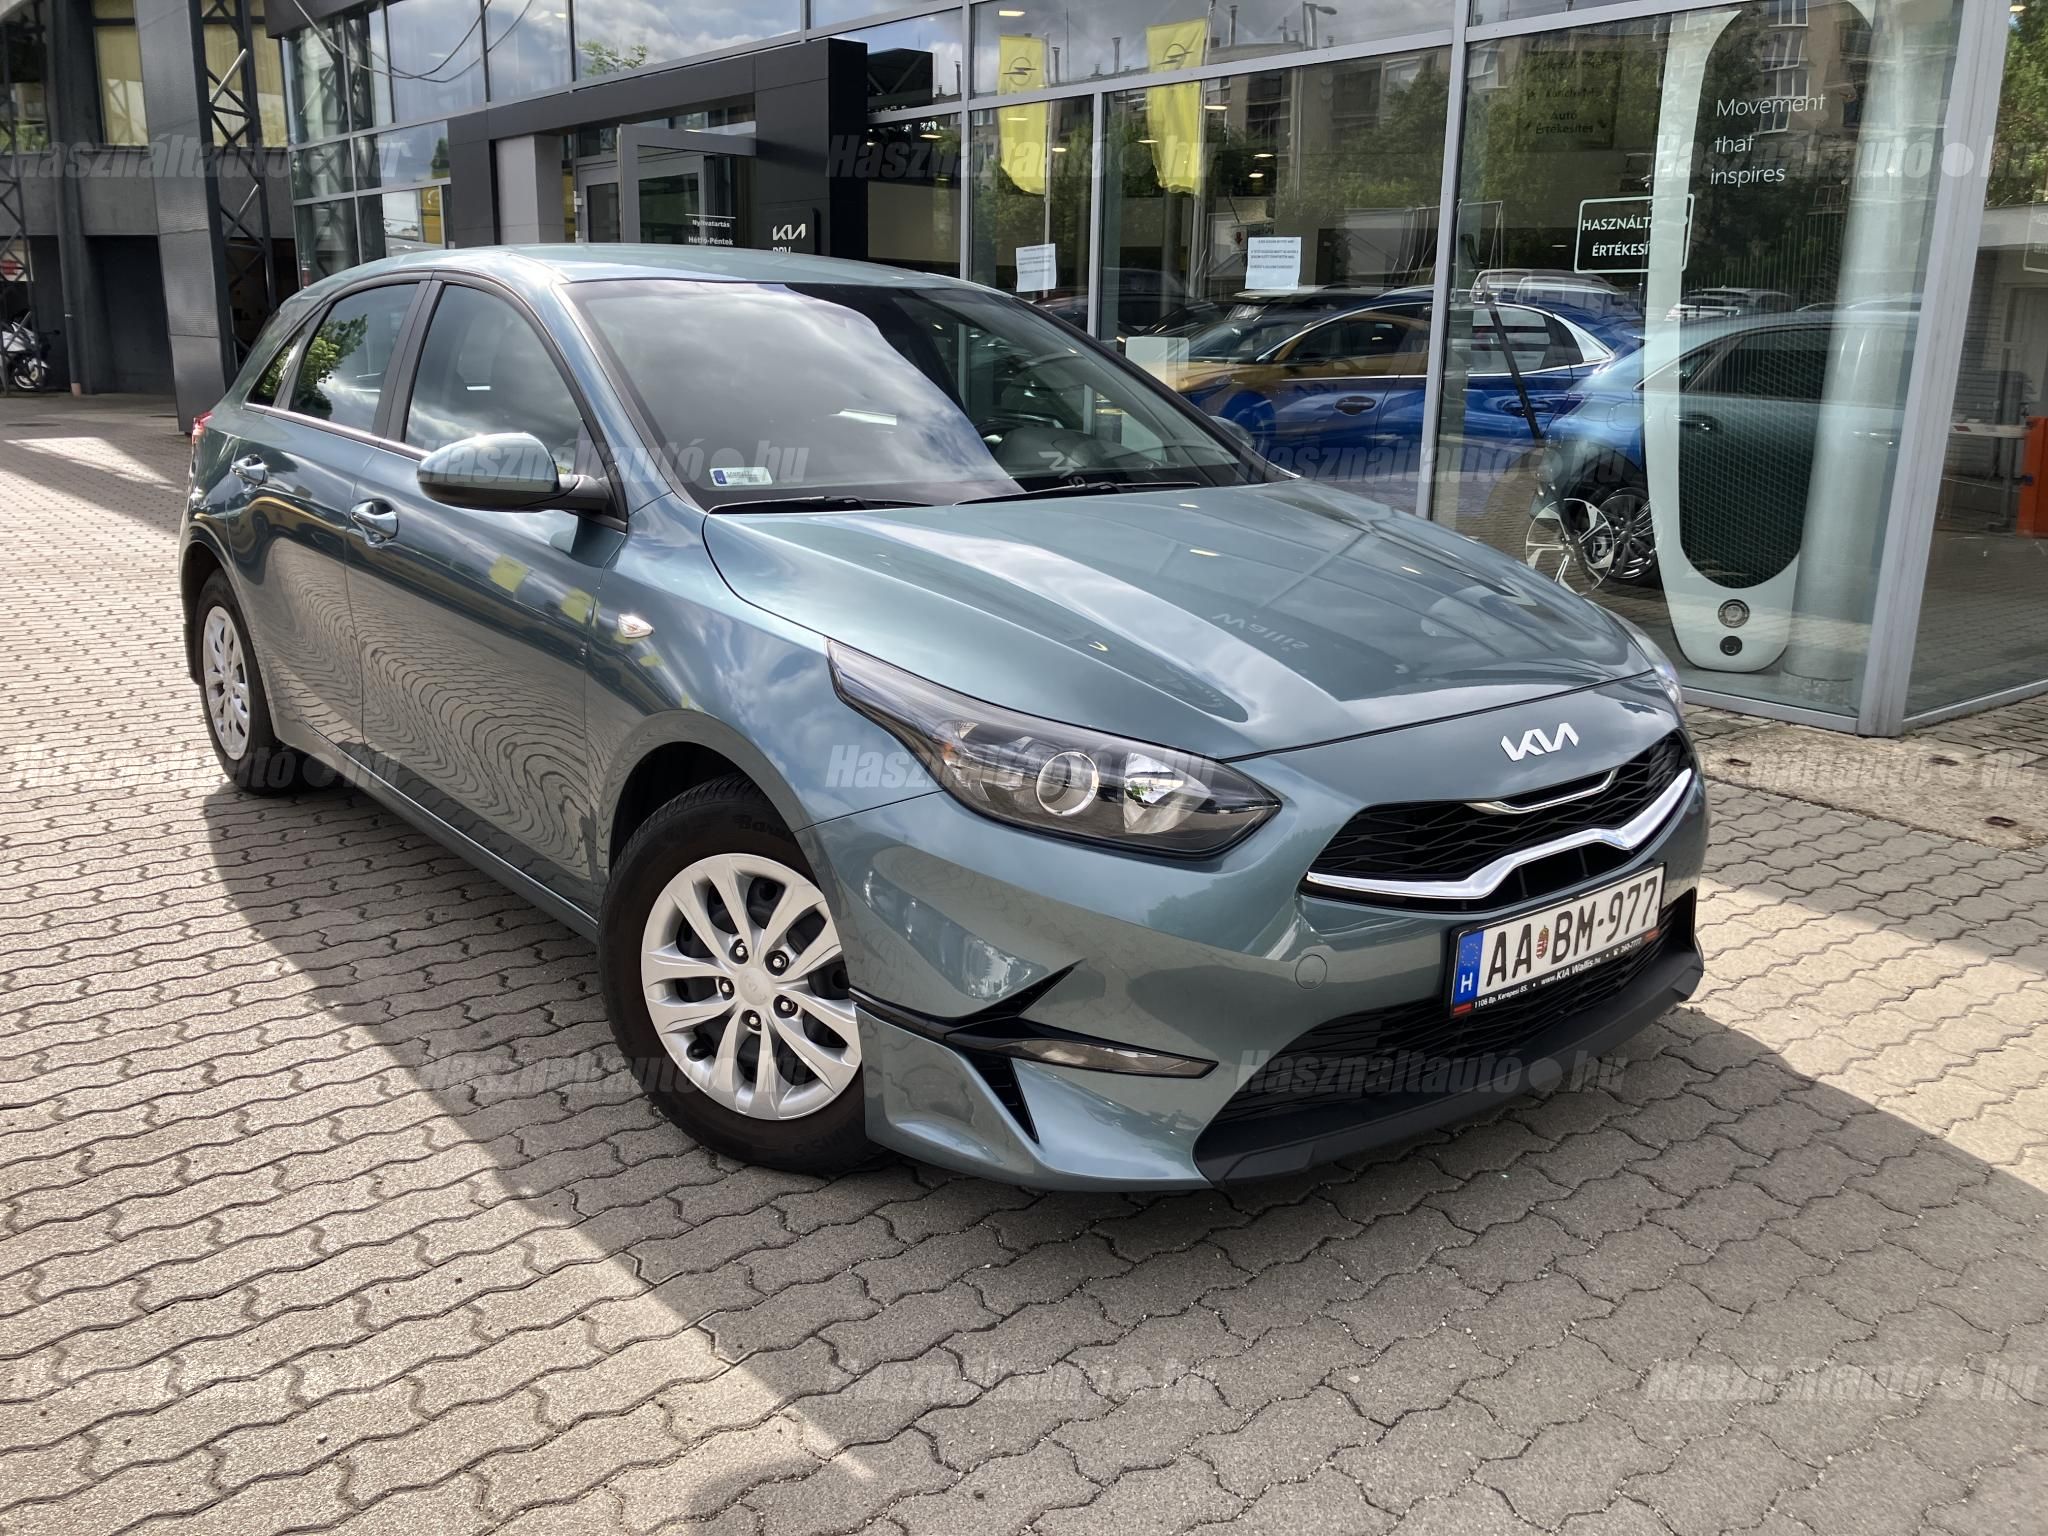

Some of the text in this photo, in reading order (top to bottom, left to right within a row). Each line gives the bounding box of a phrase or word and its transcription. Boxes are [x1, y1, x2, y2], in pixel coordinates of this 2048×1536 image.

[1716, 93, 1827, 117] Movement
[1714, 134, 1755, 153] that
[1710, 166, 1786, 188] inspires
[772, 223, 806, 241] KIA
[1591, 240, 1651, 257] ÉRTÉKESÍ
[1500, 721, 1580, 762] KIA
[1486, 875, 1658, 987] AA BM-977
[1460, 972, 1473, 994] H
